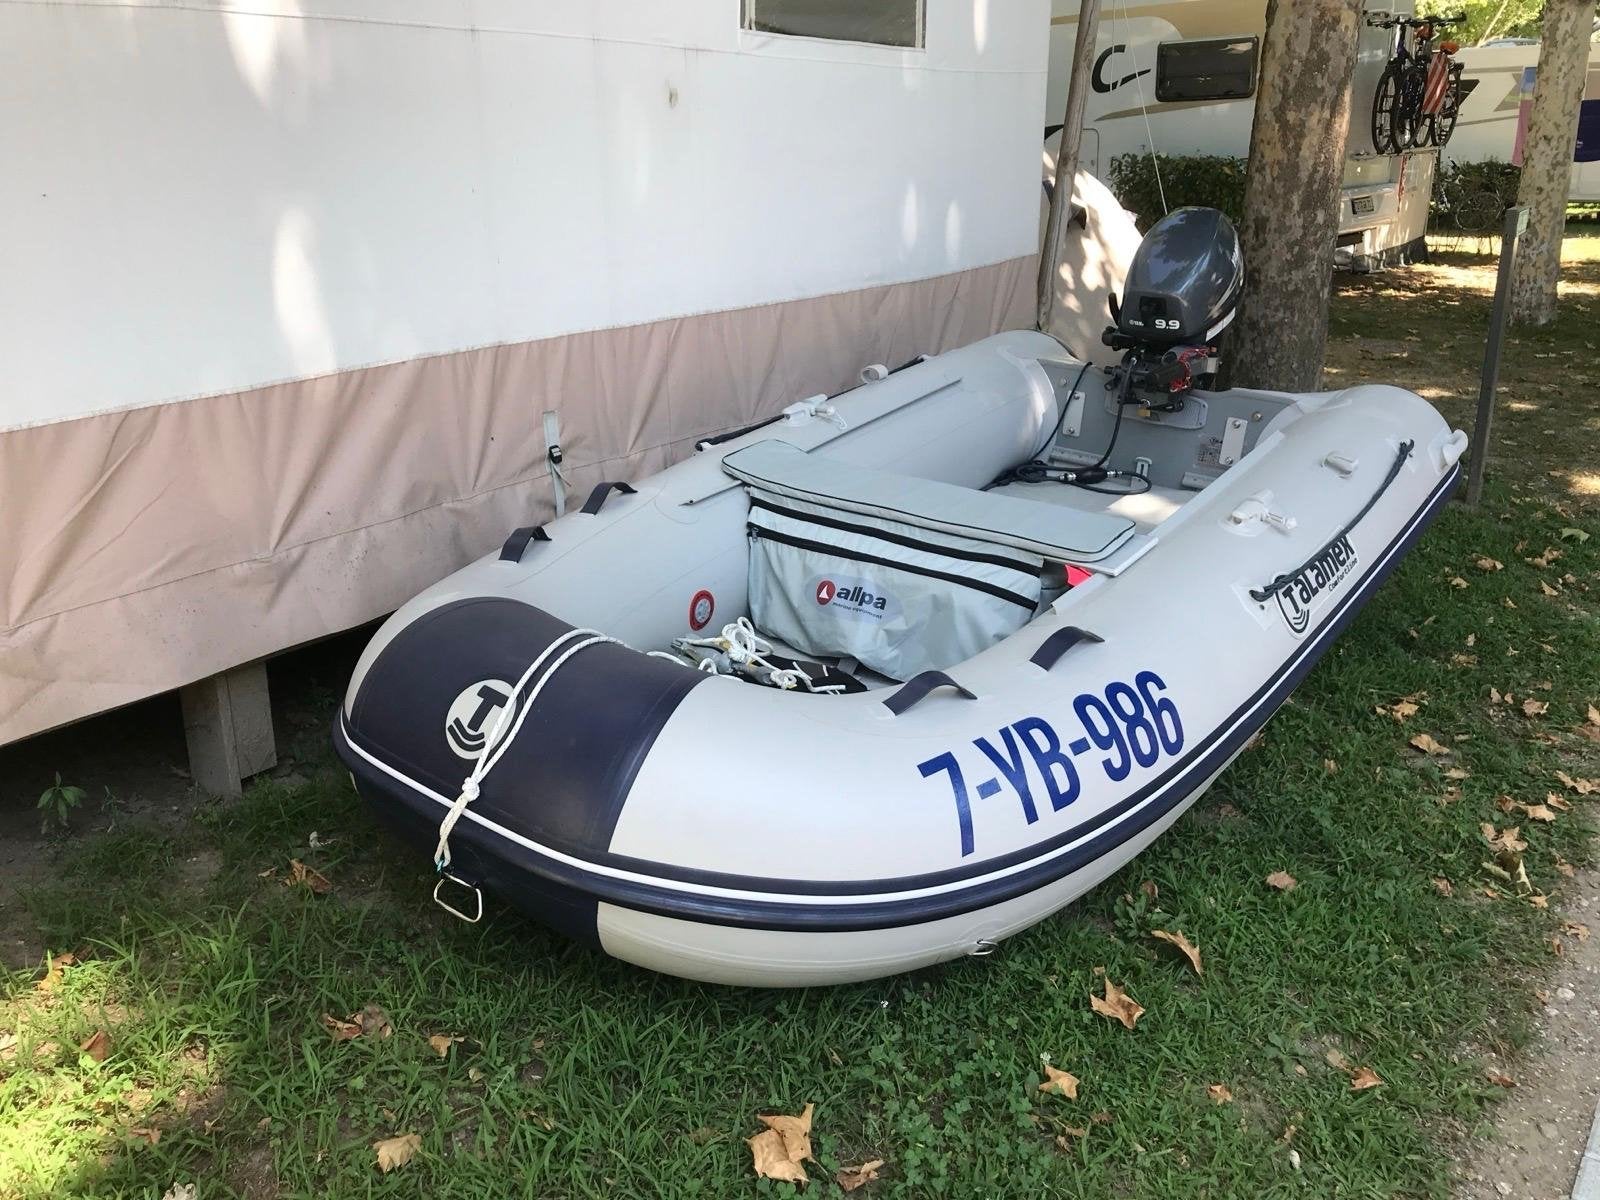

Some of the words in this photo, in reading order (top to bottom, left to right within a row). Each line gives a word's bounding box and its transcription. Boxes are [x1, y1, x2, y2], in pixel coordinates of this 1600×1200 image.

[1155, 319, 1180, 330] 9.9
[837, 586, 887, 611] allpa
[917, 671, 1184, 858] 7-YB-986
